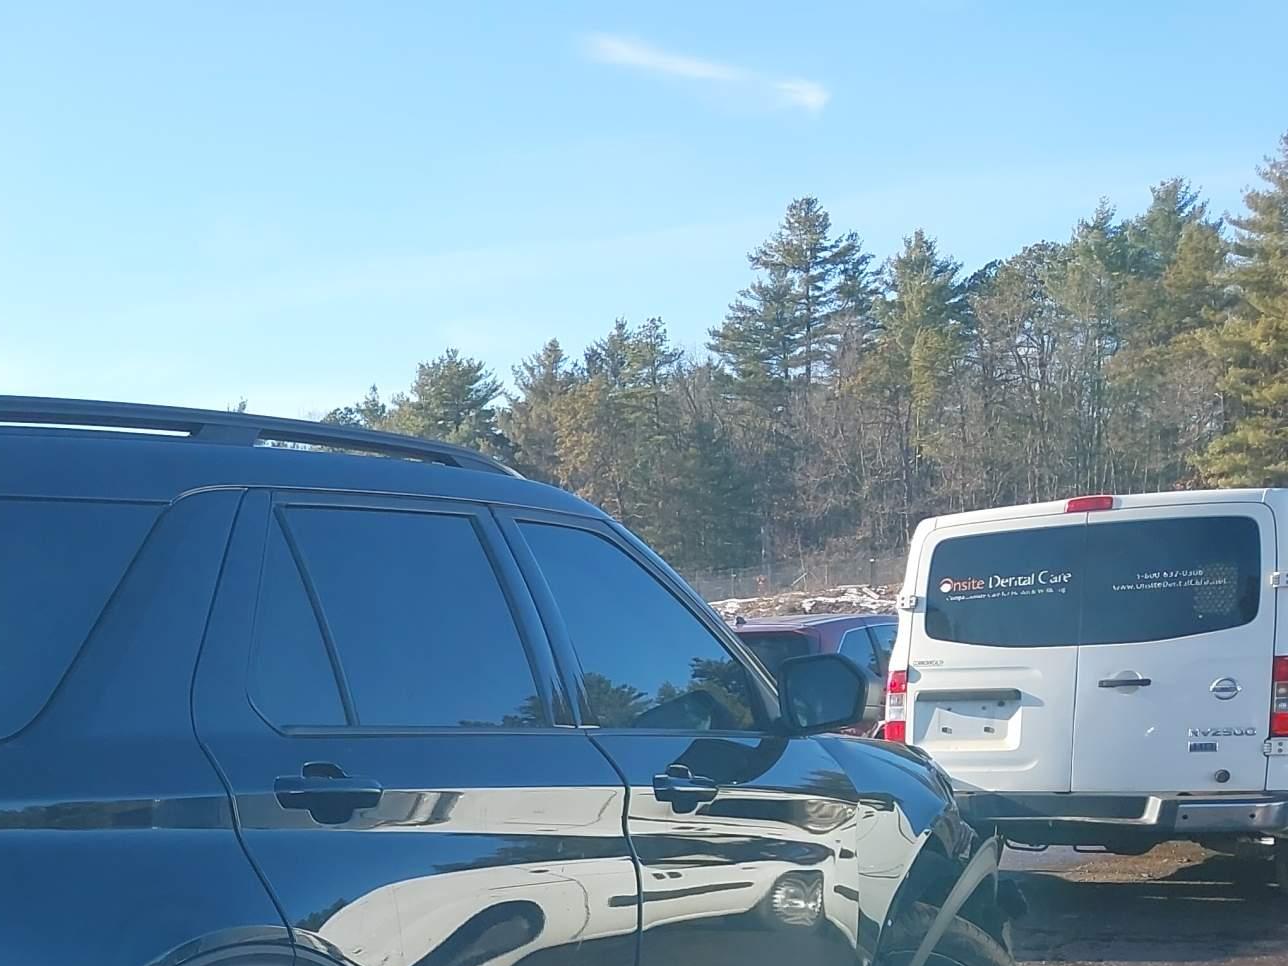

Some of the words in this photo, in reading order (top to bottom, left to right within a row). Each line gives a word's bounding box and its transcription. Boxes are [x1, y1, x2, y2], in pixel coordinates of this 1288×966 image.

[940, 577, 985, 593] Onsite
[988, 573, 1035, 589] Dental
[1038, 570, 1072, 584] Care
[1188, 728, 1257, 737] NV2500
